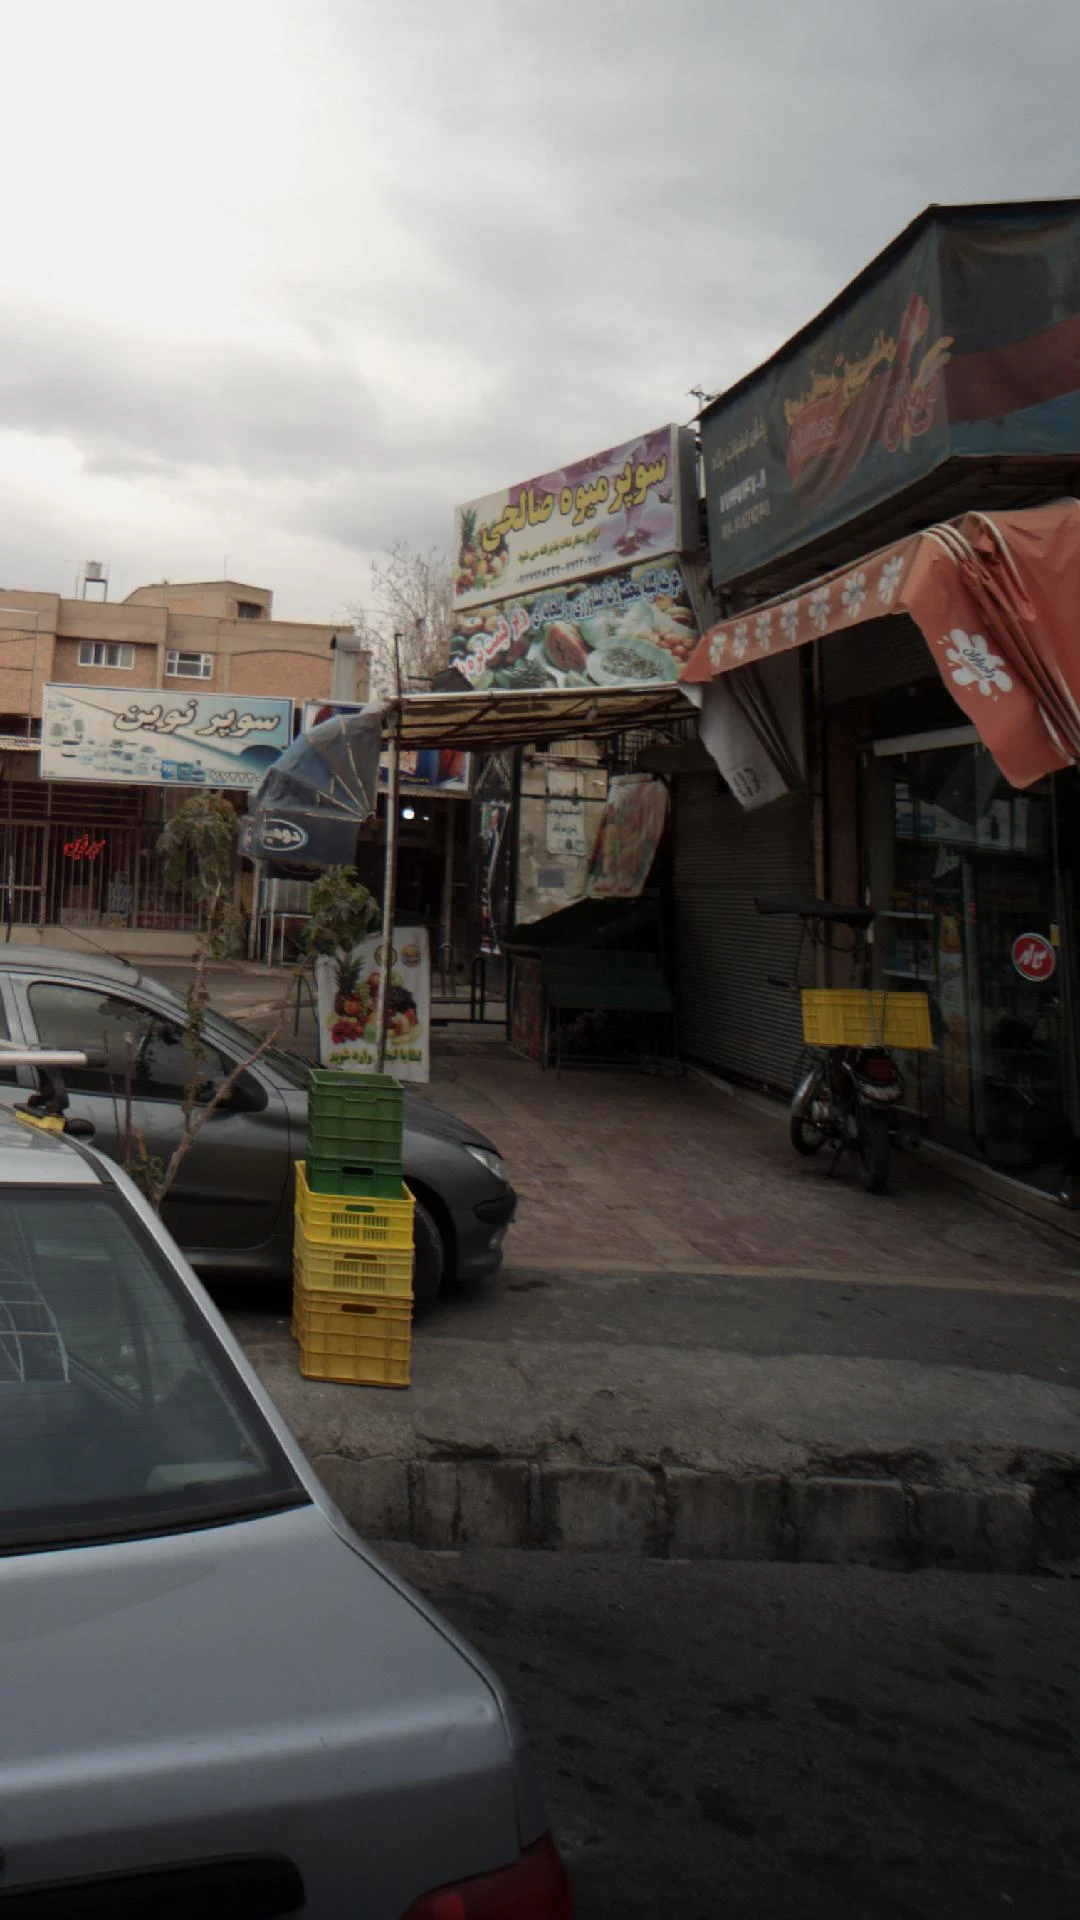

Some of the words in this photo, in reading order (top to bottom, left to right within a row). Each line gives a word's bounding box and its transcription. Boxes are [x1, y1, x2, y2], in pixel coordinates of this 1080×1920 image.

[558, 474, 609, 527] میوه
[608, 453, 668, 514] سوپر
[481, 487, 555, 552] صالحی
[113, 698, 199, 735] نوین
[195, 708, 281, 739] سوپر
